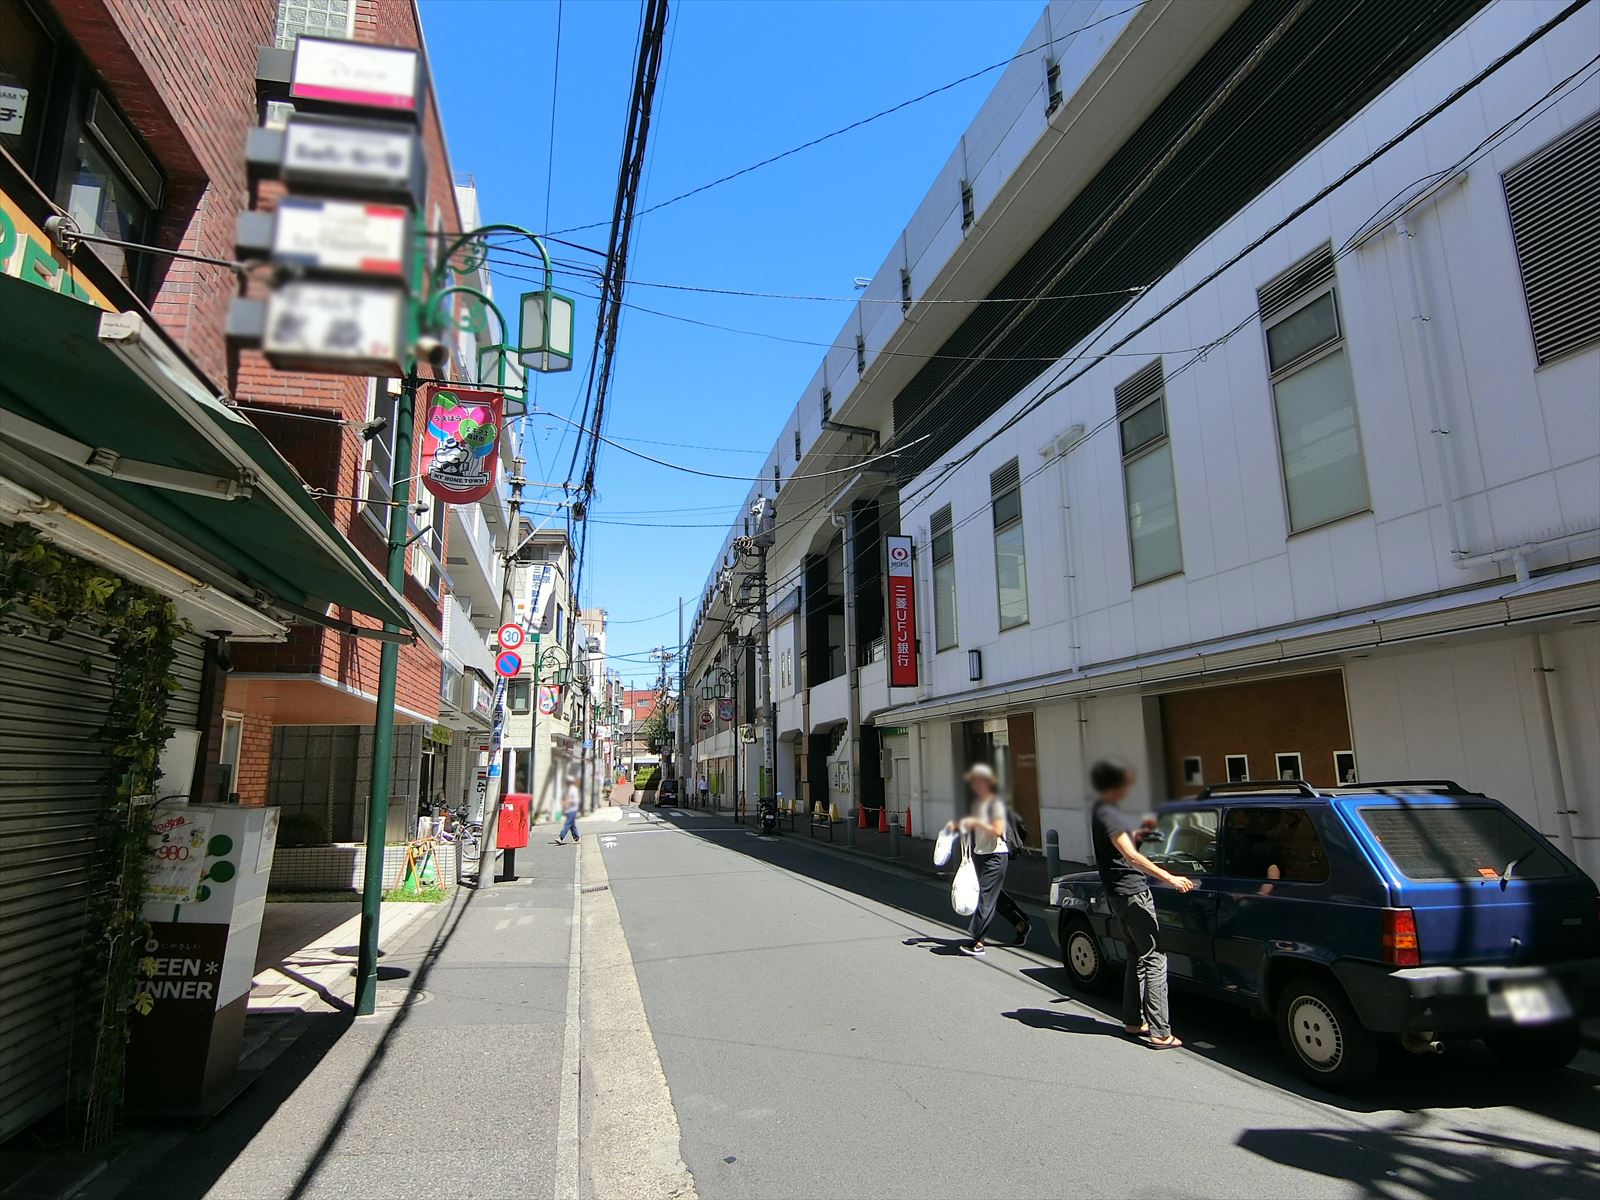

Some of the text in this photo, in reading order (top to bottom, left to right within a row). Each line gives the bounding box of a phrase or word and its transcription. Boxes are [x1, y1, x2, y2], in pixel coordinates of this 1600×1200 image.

[444, 475, 464, 484] HOME
[895, 585, 910, 668] 三菱UFJ銀行
[503, 630, 519, 643] 30
[157, 845, 189, 861] 980
